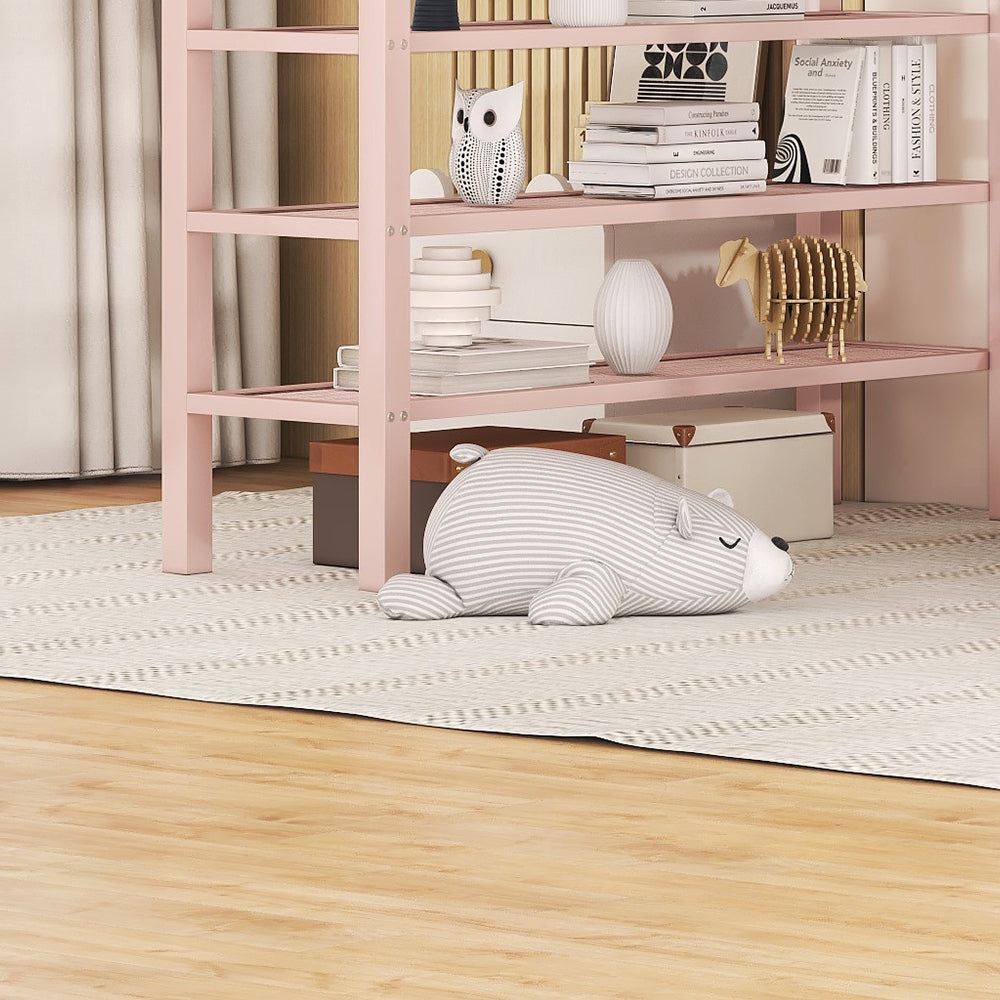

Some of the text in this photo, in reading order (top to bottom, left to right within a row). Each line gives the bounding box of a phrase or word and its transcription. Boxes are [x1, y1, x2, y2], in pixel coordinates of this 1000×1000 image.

[794, 57, 853, 70] Social Anxiety
[807, 67, 823, 77] and
[911, 59, 921, 95] STYLE
[882, 83, 890, 131] CLOTHING
[911, 109, 921, 159] FASHION
[669, 166, 749, 179] DESIGN COLLECTION
